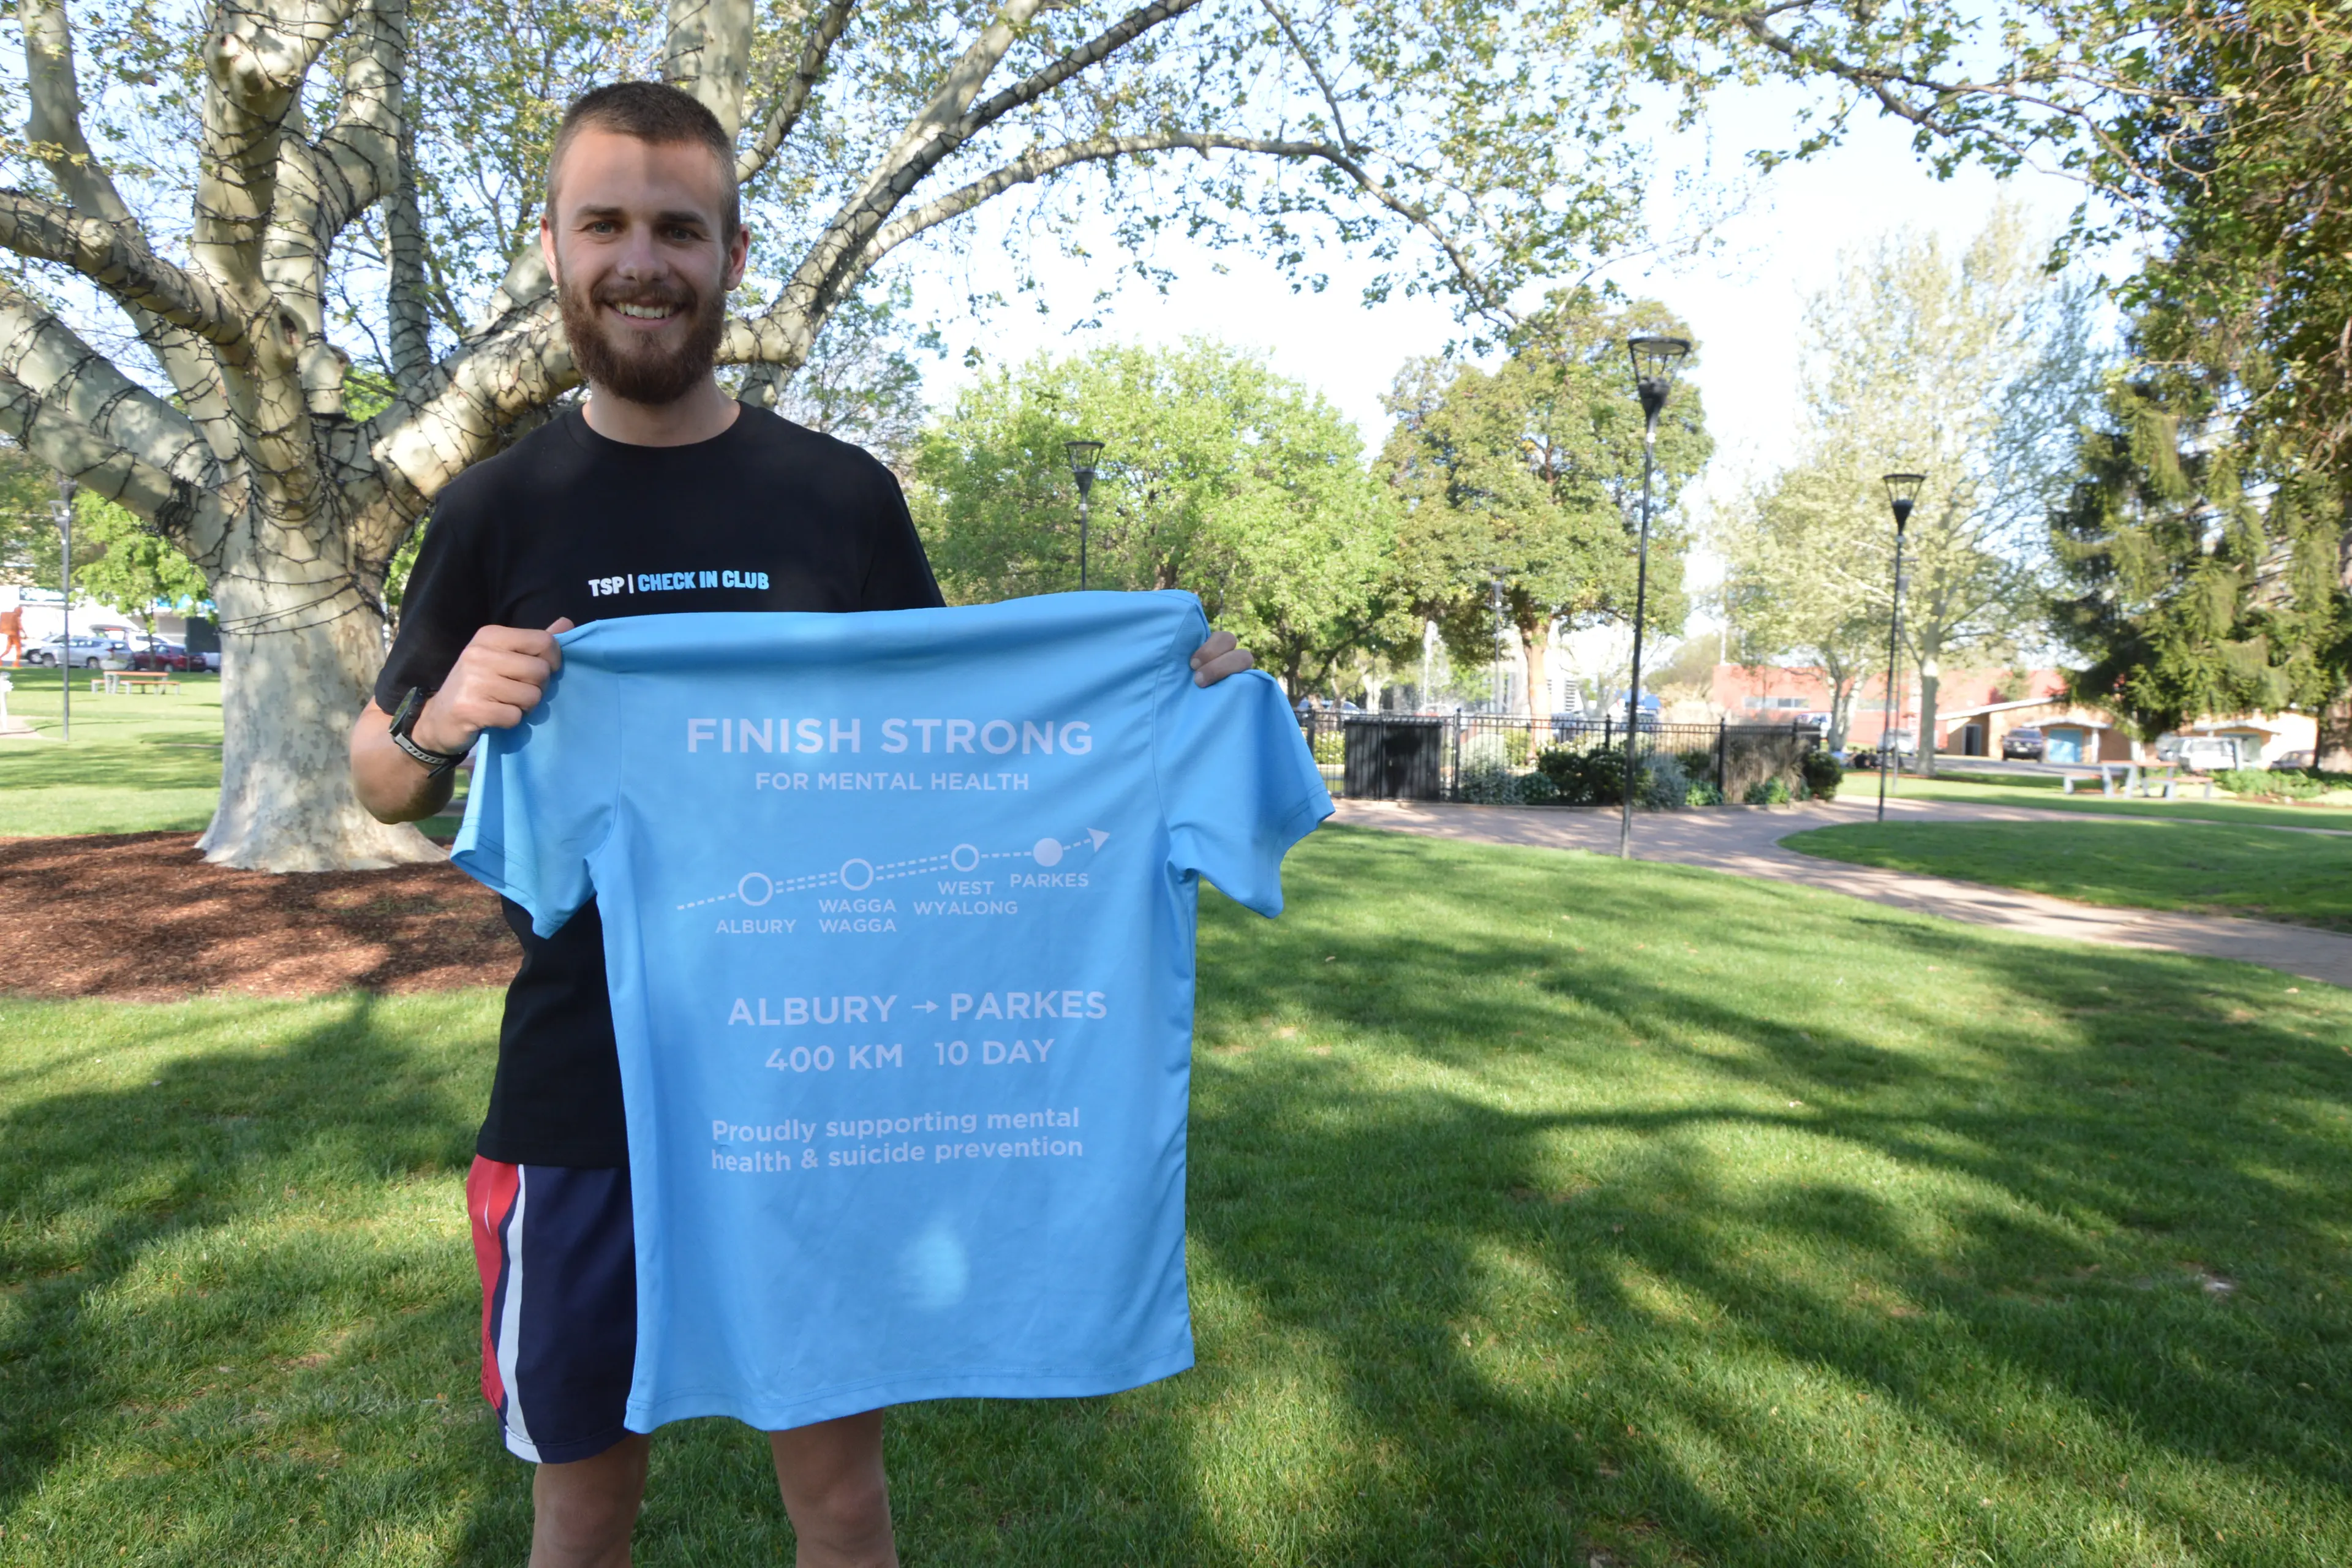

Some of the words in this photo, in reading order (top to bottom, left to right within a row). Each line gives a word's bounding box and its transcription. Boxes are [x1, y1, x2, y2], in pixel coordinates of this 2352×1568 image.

[589, 576, 625, 597] TSP
[638, 571, 696, 592] CHECK
[699, 570, 718, 588] IN
[722, 570, 769, 590] CLUB
[687, 718, 861, 754] FINISH
[880, 718, 1093, 756] STRONG
[755, 772, 809, 791] FOR
[818, 772, 922, 791] MENTAL
[930, 772, 1028, 791] HEALTH
[938, 880, 995, 896] WEST
[1009, 872, 1090, 889] PARKES
[818, 899, 897, 914] WAGGA
[913, 900, 1018, 916] WYALONG
[715, 919, 797, 934] ALBURY
[818, 918, 897, 933] WAGGA
[727, 995, 898, 1026] ALBURY
[950, 990, 1107, 1022] PARKES
[765, 1044, 835, 1073] 400
[850, 1043, 903, 1070] KM
[934, 1041, 969, 1066] 10
[982, 1038, 1055, 1065] DAY
[712, 1118, 817, 1144] Proudly
[825, 1111, 978, 1140] supporting
[987, 1107, 1079, 1130] mental
[711, 1149, 791, 1173] health
[801, 1148, 818, 1169] &
[827, 1142, 925, 1167] suicide
[935, 1137, 1083, 1164] prevention
